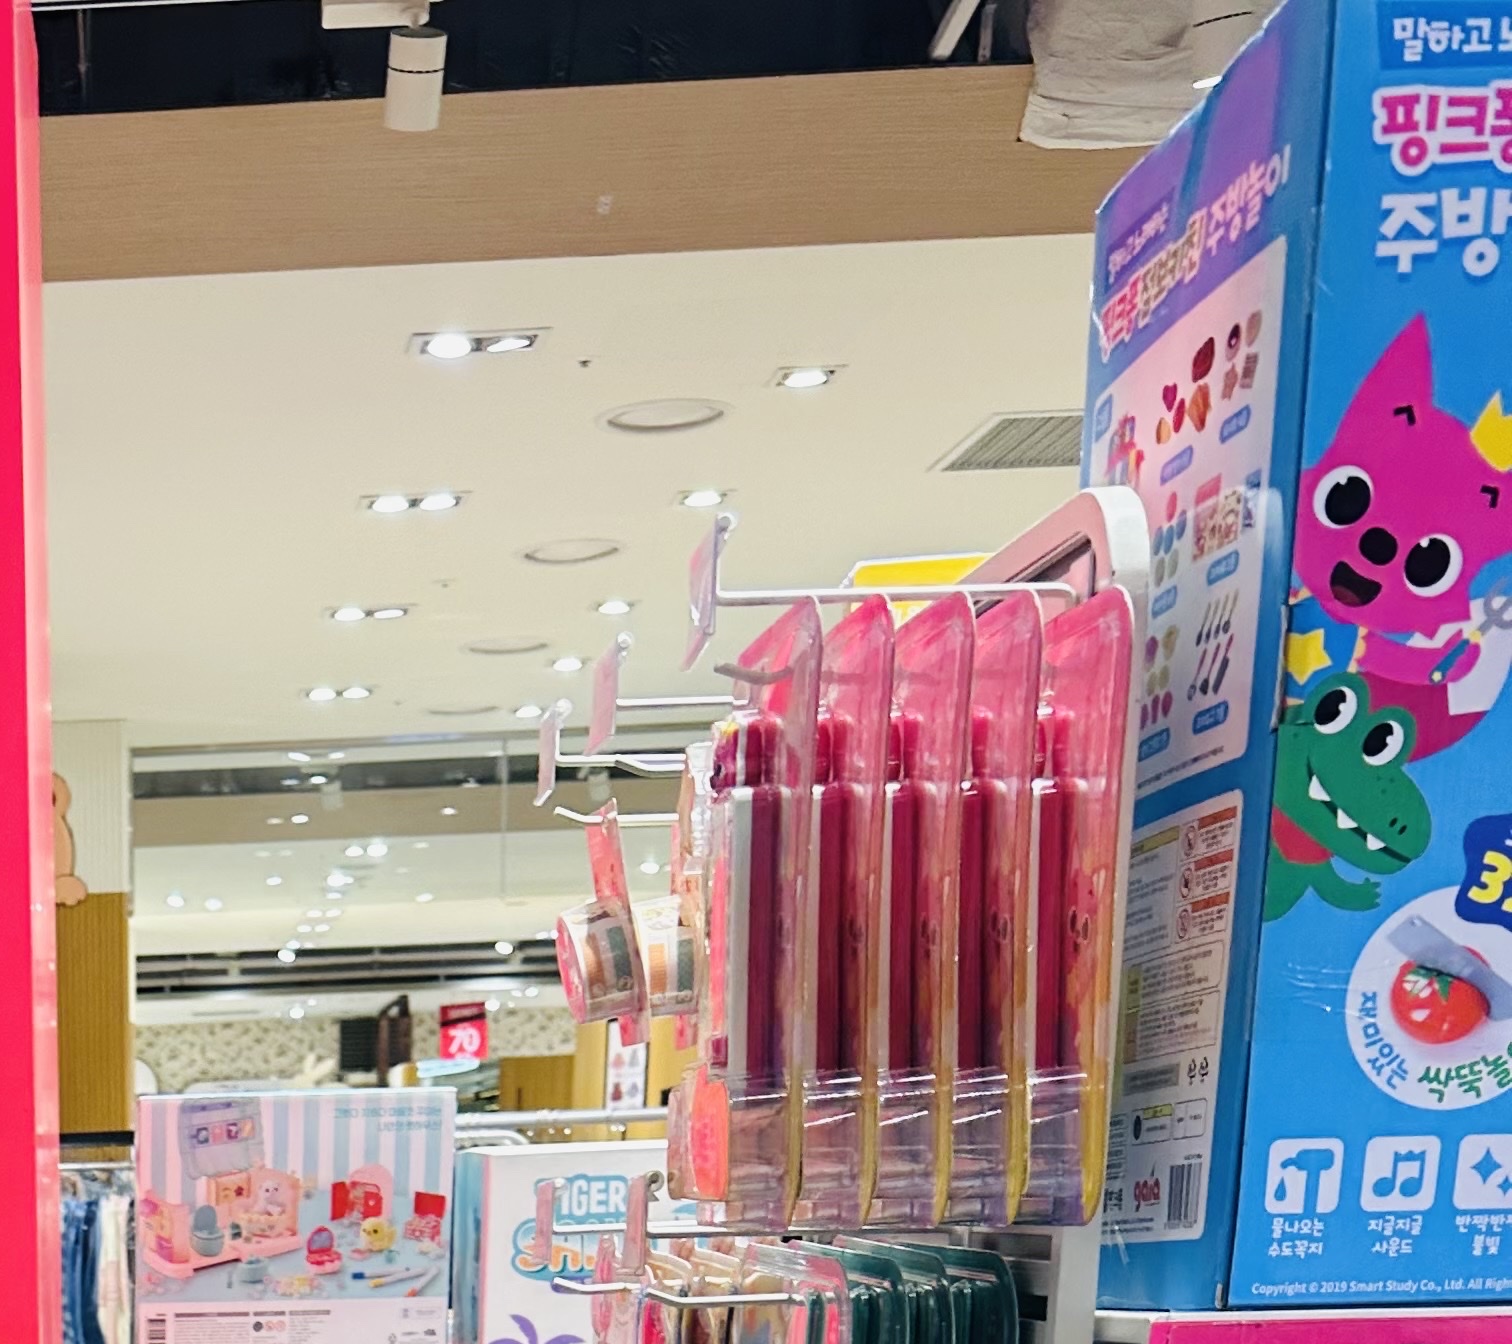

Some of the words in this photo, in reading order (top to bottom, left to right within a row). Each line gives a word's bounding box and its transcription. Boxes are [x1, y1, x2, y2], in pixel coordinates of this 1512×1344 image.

[1393, 17, 1492, 62] 말하고
[449, 1027, 481, 1054] 70
[1360, 991, 1408, 1090] 재미있는
[1418, 1041, 1512, 1103] 싹뚝놀
[538, 1178, 627, 1217] IGER
[1271, 1217, 1325, 1238] 물나오는
[1368, 1215, 1423, 1236] 지글지글
[1268, 1240, 1323, 1259] 수도꼭지
[1372, 1237, 1413, 1257] 사운드
[1251, 1282, 1307, 1297] Copyright
[1320, 1281, 1347, 1293] 2019
[1349, 1281, 1384, 1293] Smart
[1385, 1279, 1418, 1294] Study
[1420, 1279, 1442, 1292] Co.,
[1445, 1278, 1466, 1291] Ltd.
[1468, 1278, 1483, 1290] All
